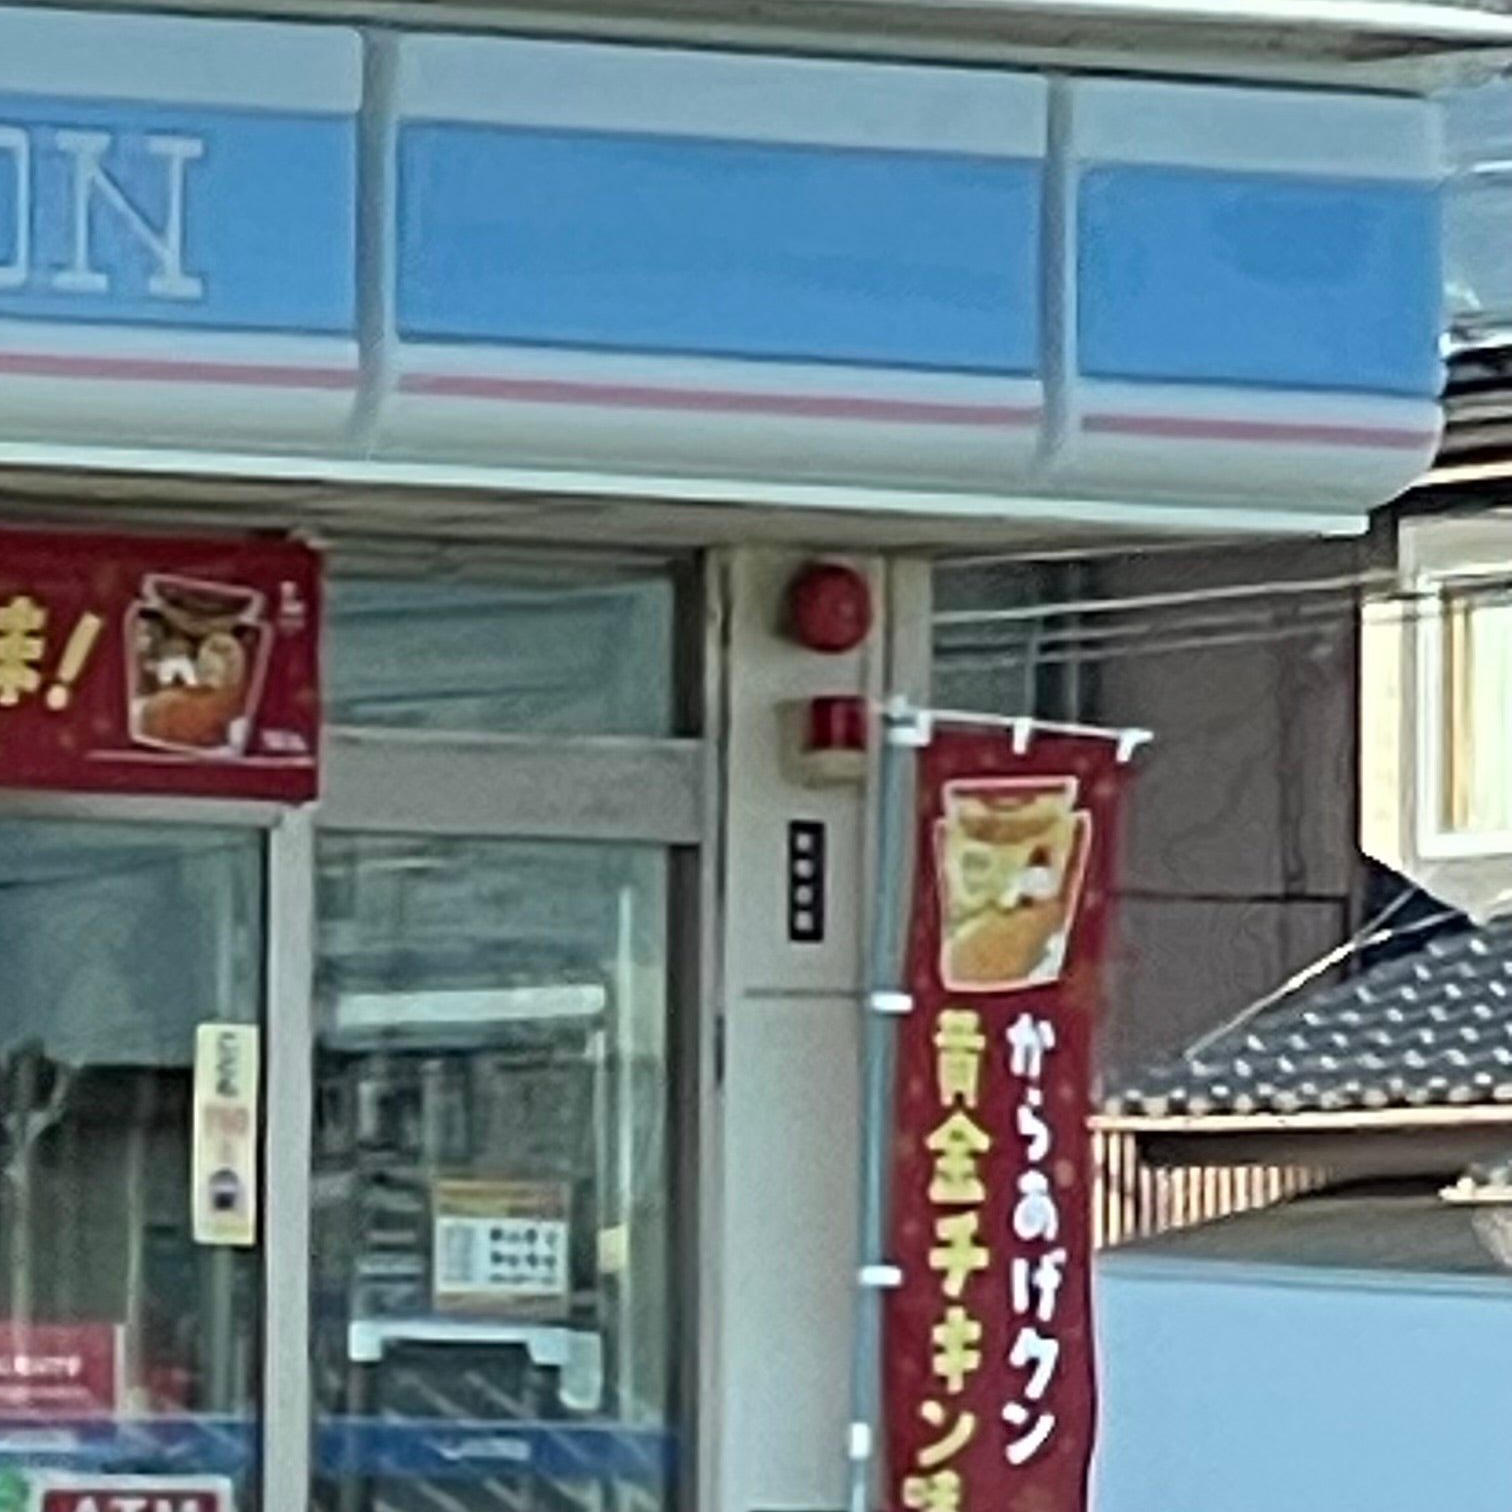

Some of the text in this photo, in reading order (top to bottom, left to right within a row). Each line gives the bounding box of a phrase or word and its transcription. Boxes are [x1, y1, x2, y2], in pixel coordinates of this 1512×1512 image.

[1000, 1012, 1068, 1466] からあげクン
